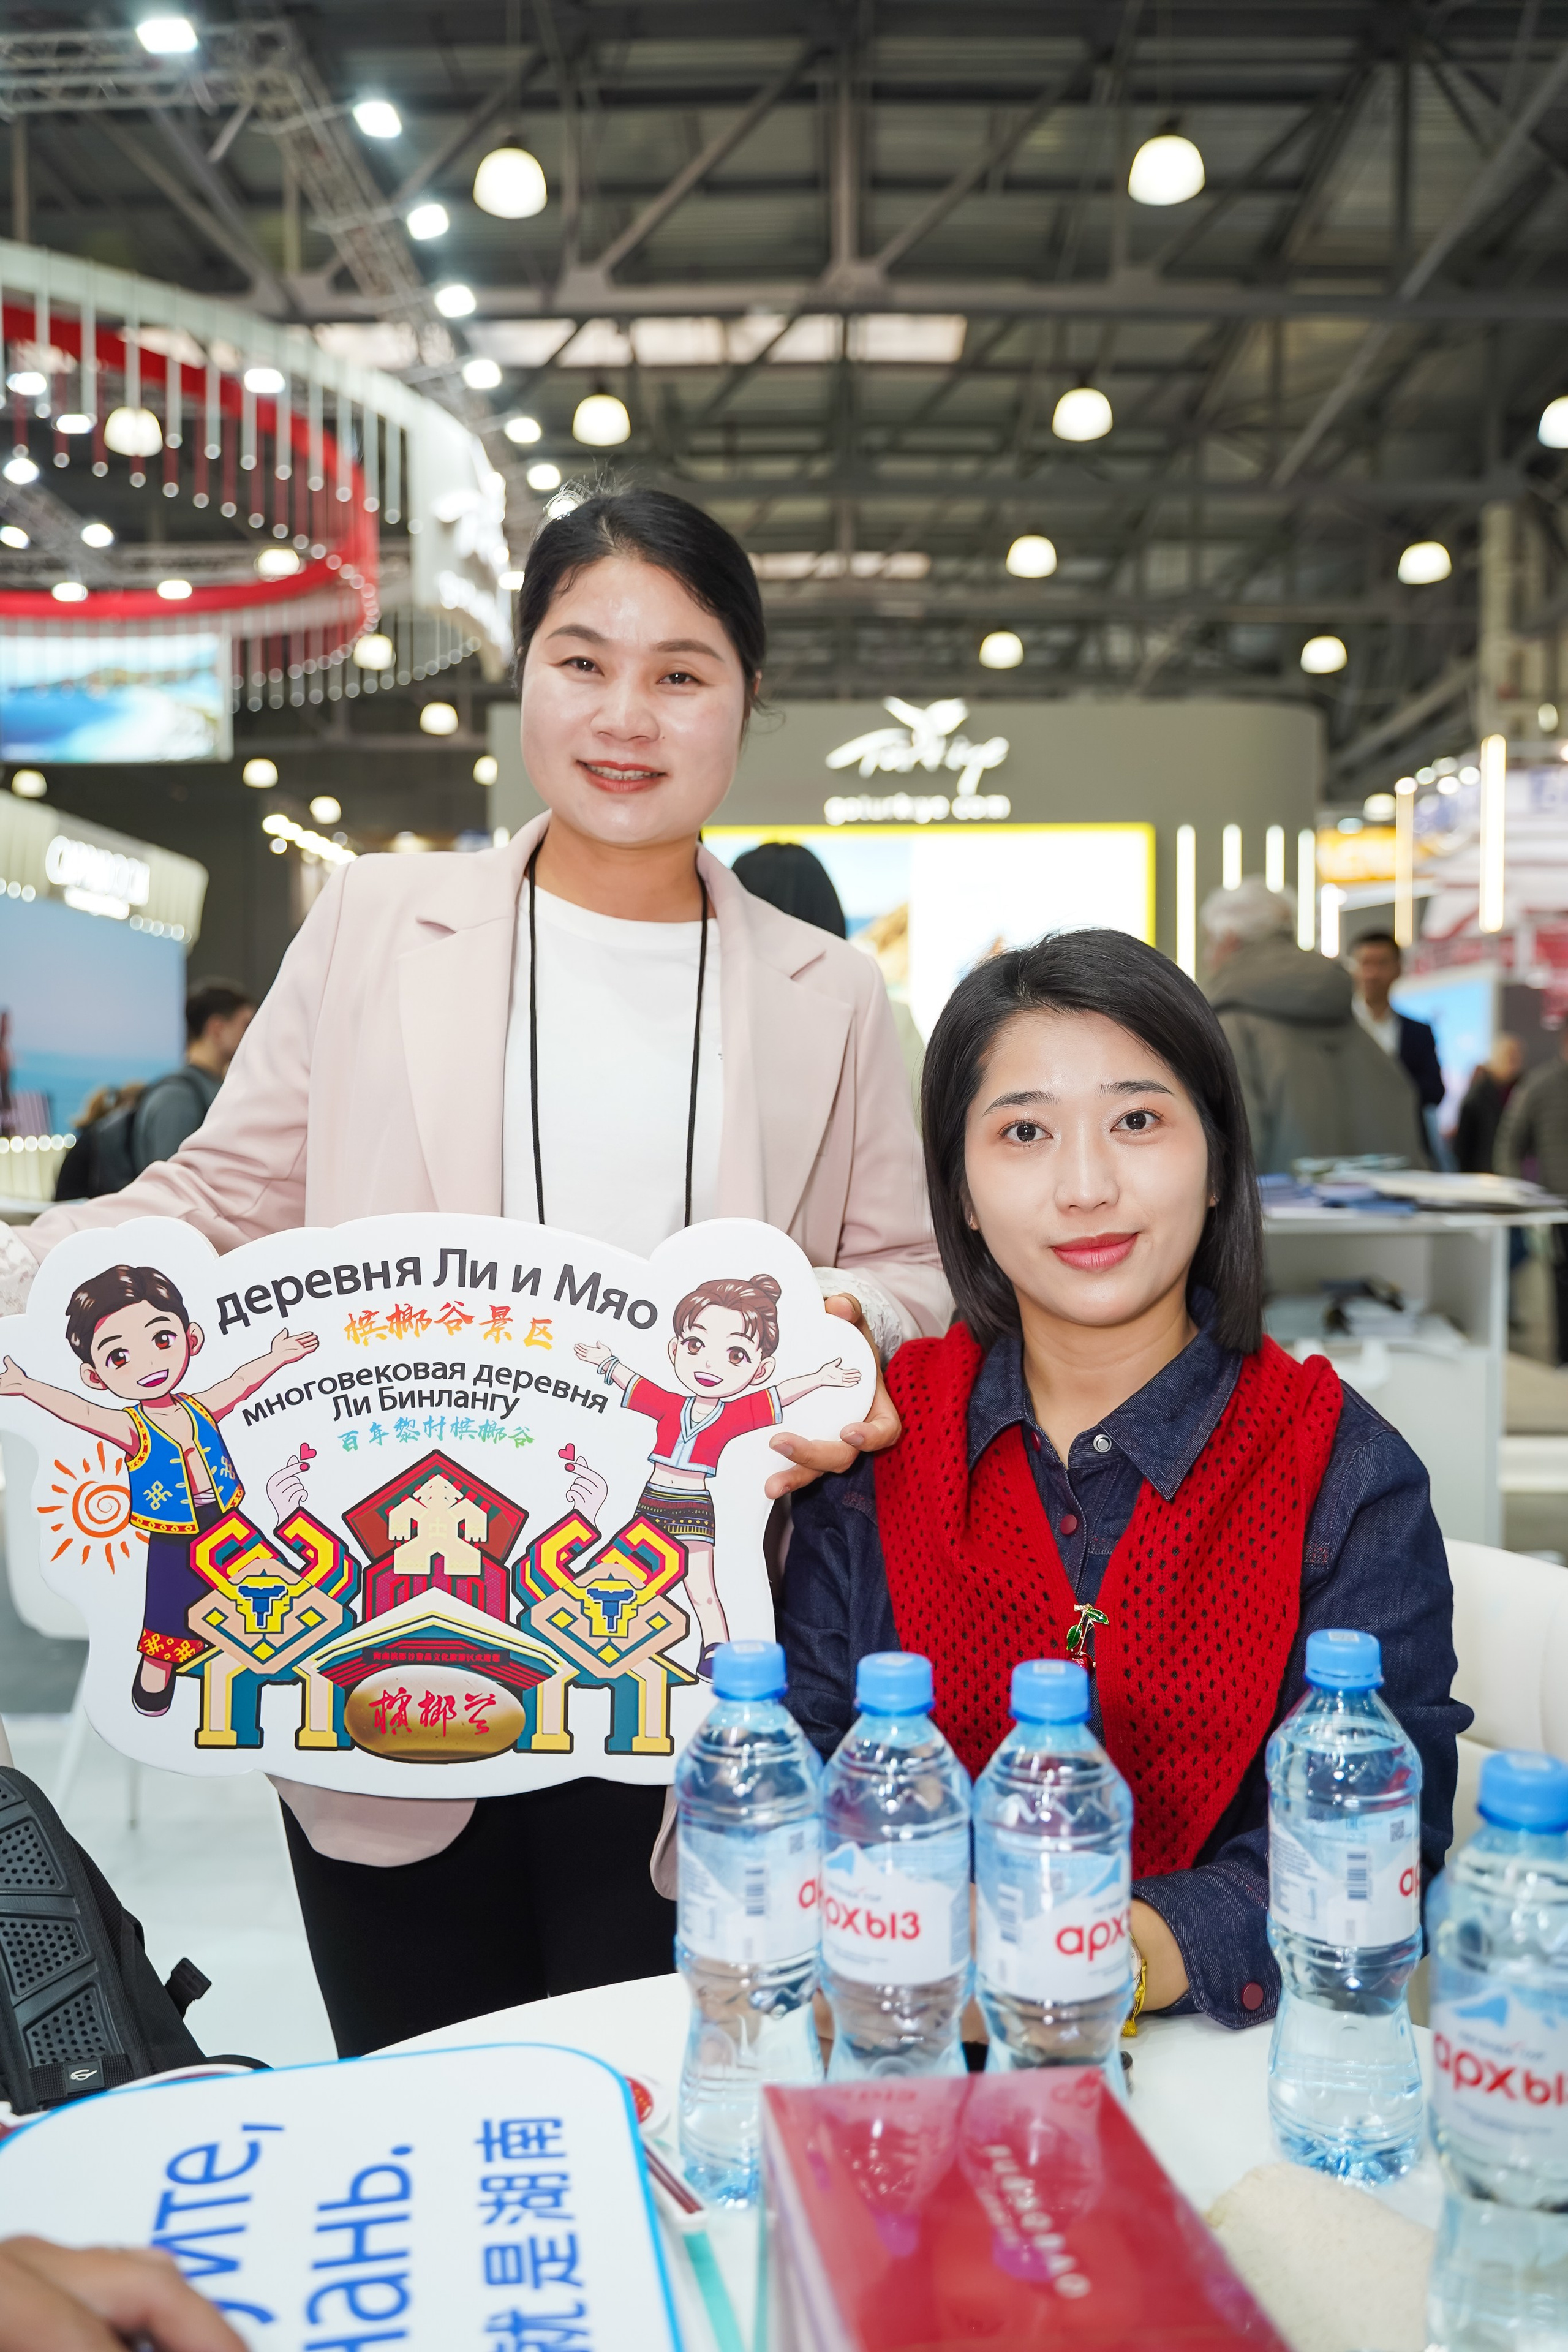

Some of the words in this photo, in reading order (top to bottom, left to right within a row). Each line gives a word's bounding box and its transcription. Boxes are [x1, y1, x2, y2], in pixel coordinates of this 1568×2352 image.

[217, 1257, 422, 1336] деревня
[432, 1248, 498, 1291] Ли
[511, 1264, 542, 1297] и
[554, 1264, 658, 1330] Мяо
[343, 1300, 554, 1351] 槟榔谷景区
[242, 1362, 466, 1427] многовековая
[473, 1364, 609, 1414] деревня
[333, 1394, 372, 1422] Ли
[378, 1385, 521, 1420] Бинлангу
[337, 1415, 536, 1452] 百年黎村槟榔谷
[1055, 1908, 1131, 1962] арх
[1433, 2032, 1568, 2107] архы
